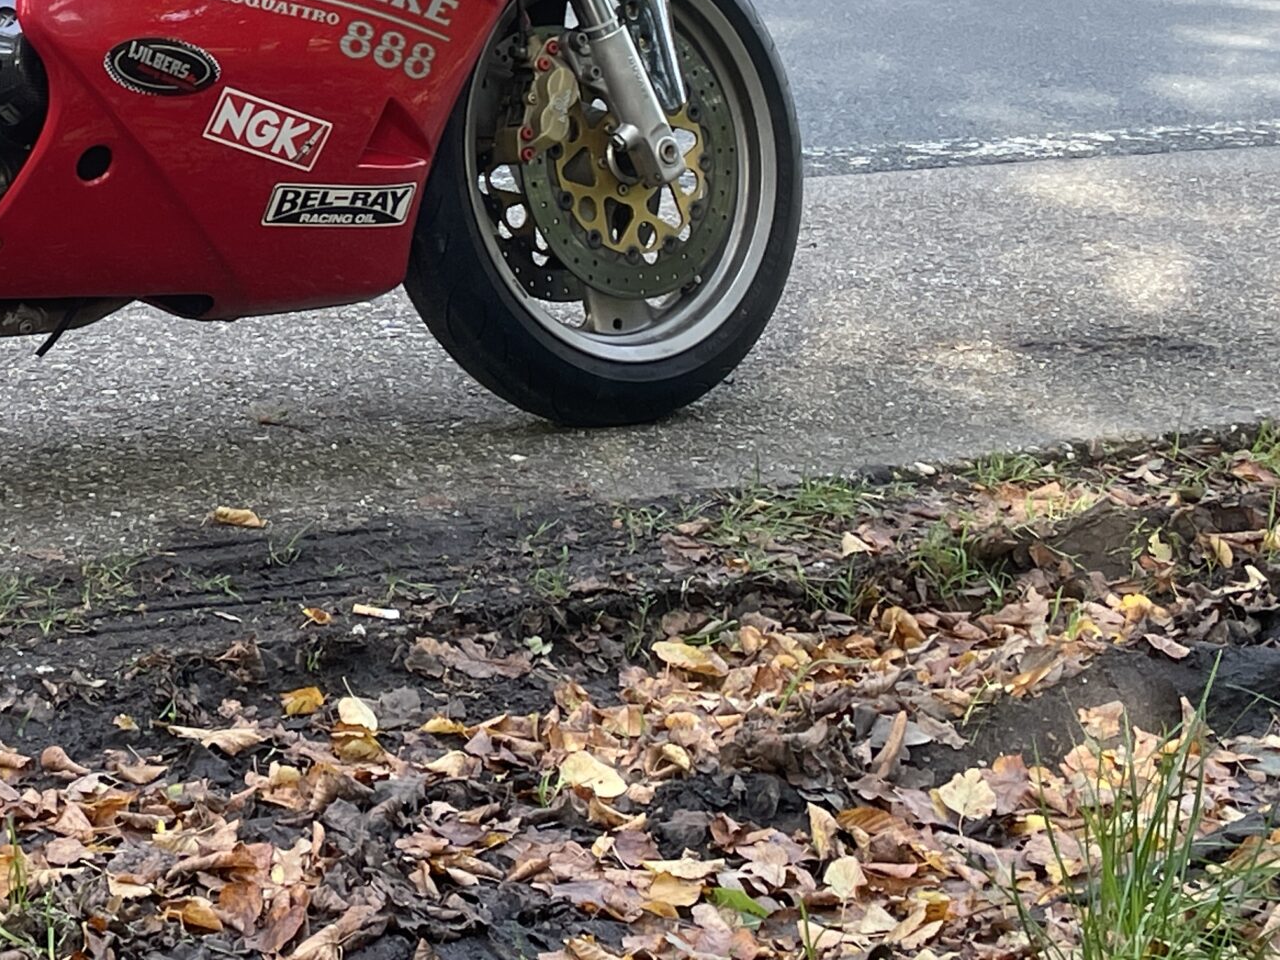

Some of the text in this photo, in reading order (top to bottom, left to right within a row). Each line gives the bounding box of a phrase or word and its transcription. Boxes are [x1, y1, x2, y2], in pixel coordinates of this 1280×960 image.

[127, 40, 192, 80] WILBERS
[339, 20, 436, 80] 888
[211, 94, 311, 161] NGK
[272, 189, 411, 218] BEL-RAY
[299, 213, 377, 224] RACING OIL
